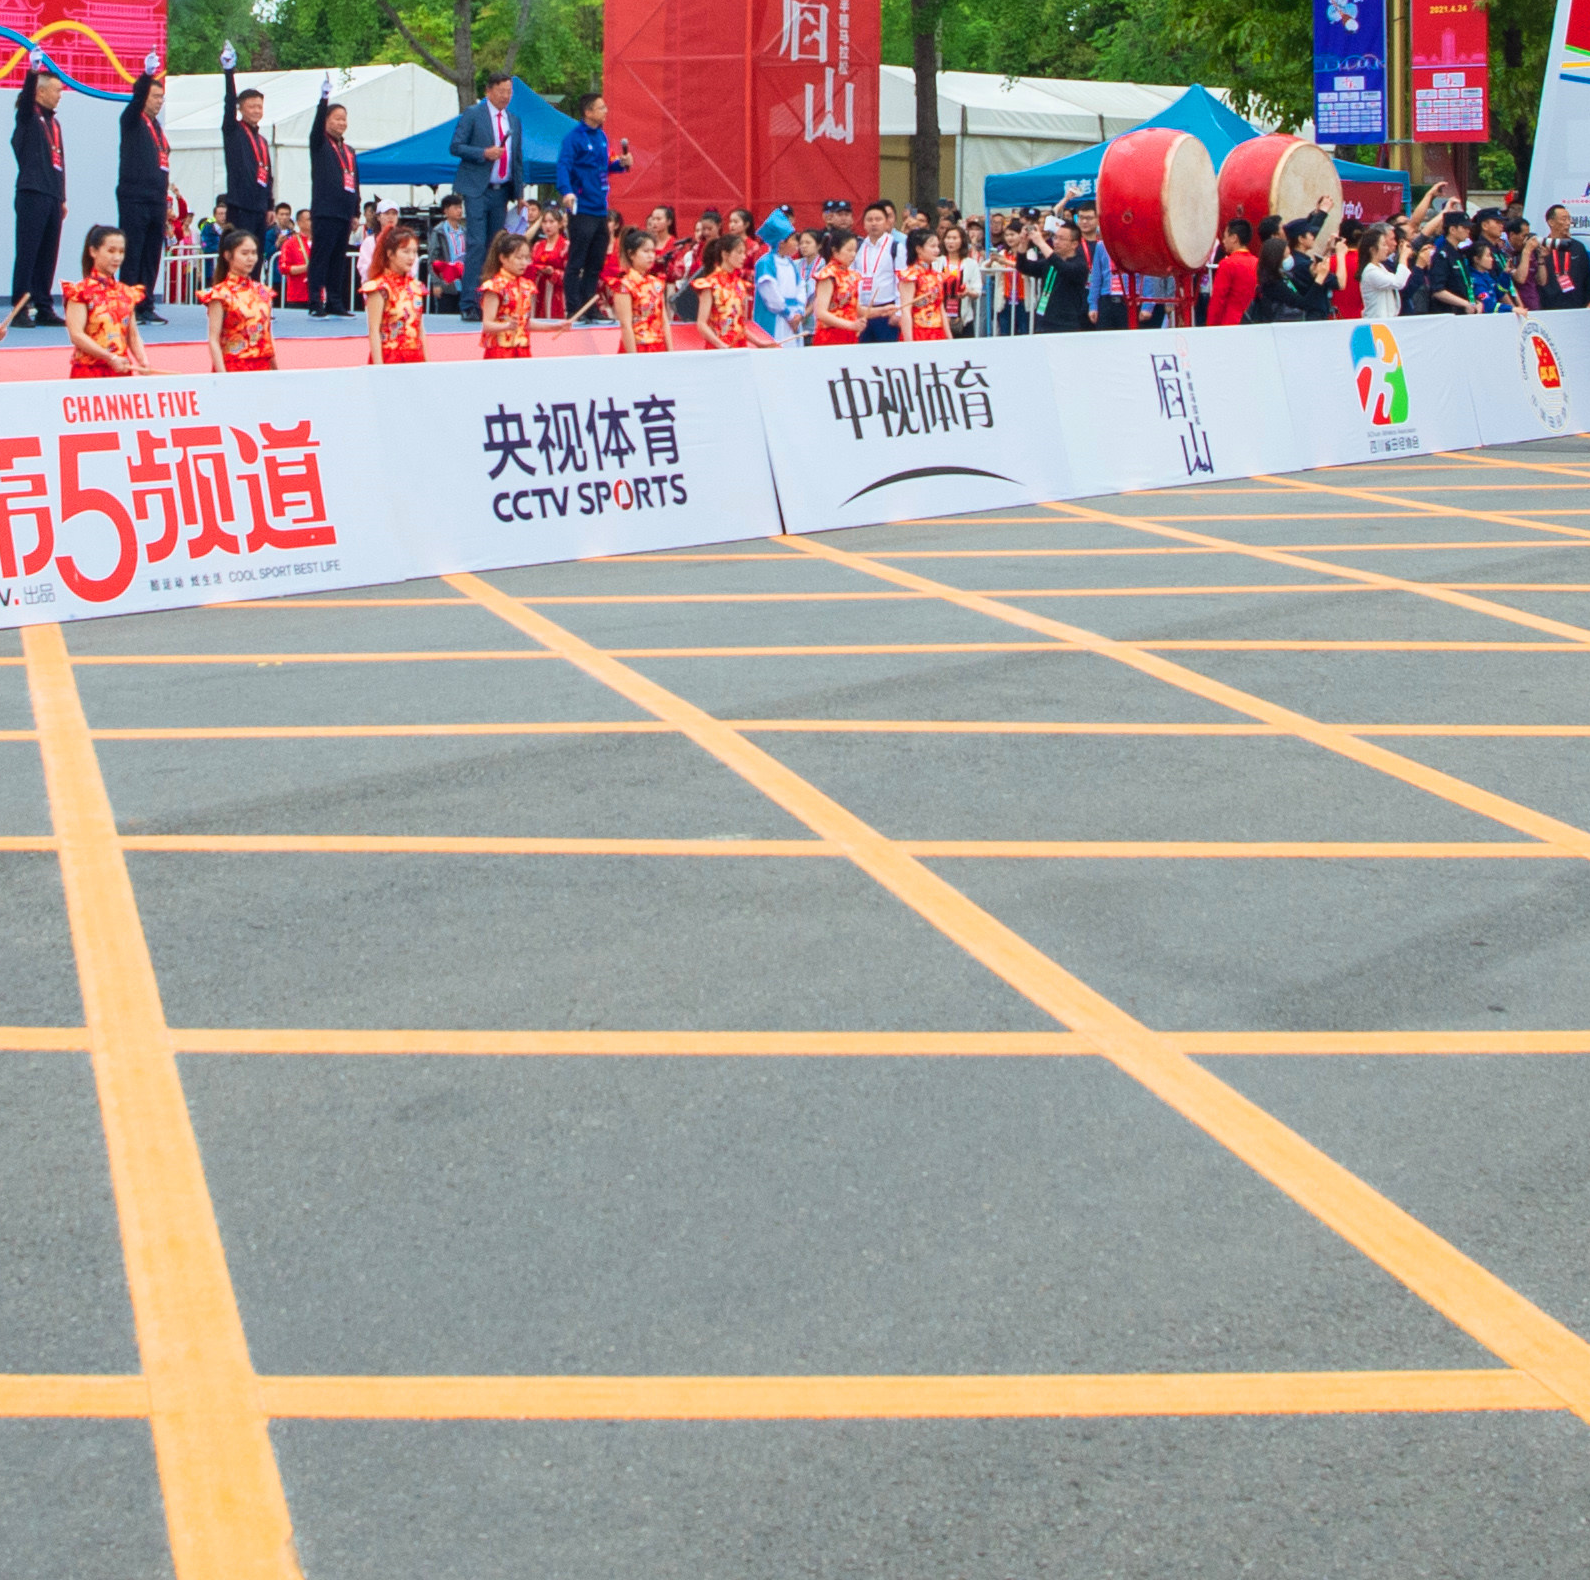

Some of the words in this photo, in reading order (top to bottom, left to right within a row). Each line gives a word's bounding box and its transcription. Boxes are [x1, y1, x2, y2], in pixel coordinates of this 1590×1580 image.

[62, 393, 156, 424] CHANNEL
[157, 390, 201, 419] FIVE
[826, 360, 995, 440] 中视体育
[483, 393, 681, 480] 央视体育
[492, 484, 570, 522] CCTV
[576, 473, 689, 516] SPORTS
[228, 569, 258, 584] COOL
[258, 565, 293, 581] SPORT
[294, 561, 319, 577] BEST
[320, 558, 342, 573] LIFE
